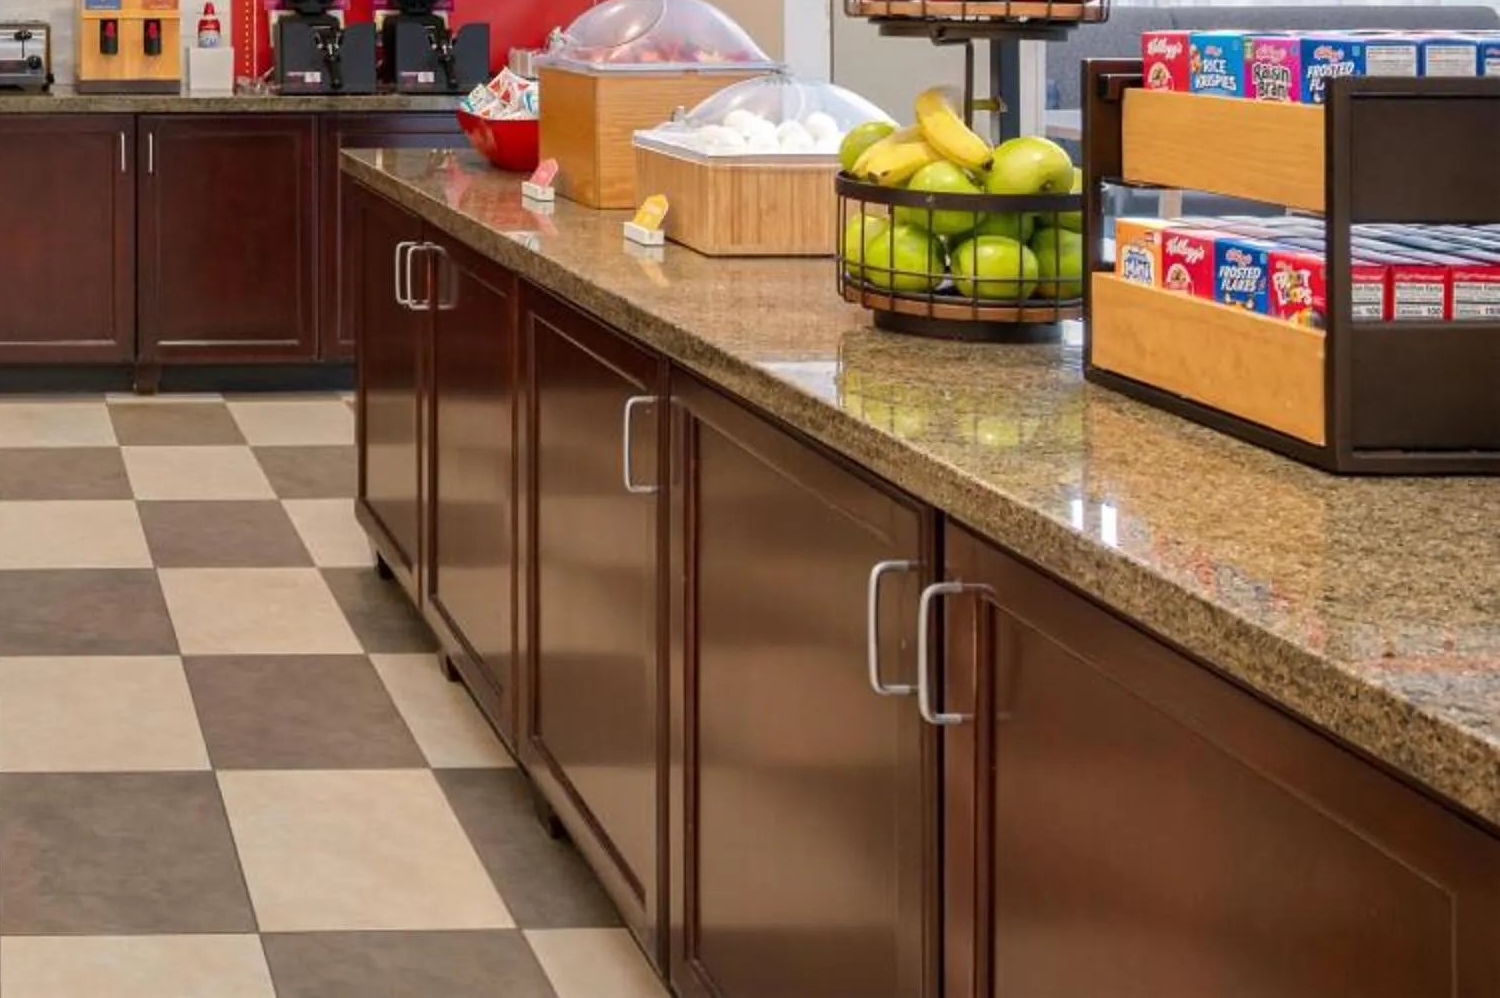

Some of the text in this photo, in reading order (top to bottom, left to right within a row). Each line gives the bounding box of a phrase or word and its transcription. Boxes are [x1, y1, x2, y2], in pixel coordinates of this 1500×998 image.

[1203, 58, 1228, 74] RICE
[1252, 63, 1291, 84] Raisin
[1307, 62, 1355, 79] FROSTED
[1195, 74, 1237, 91] KRISPIES
[1219, 266, 1262, 282] FROSTED
